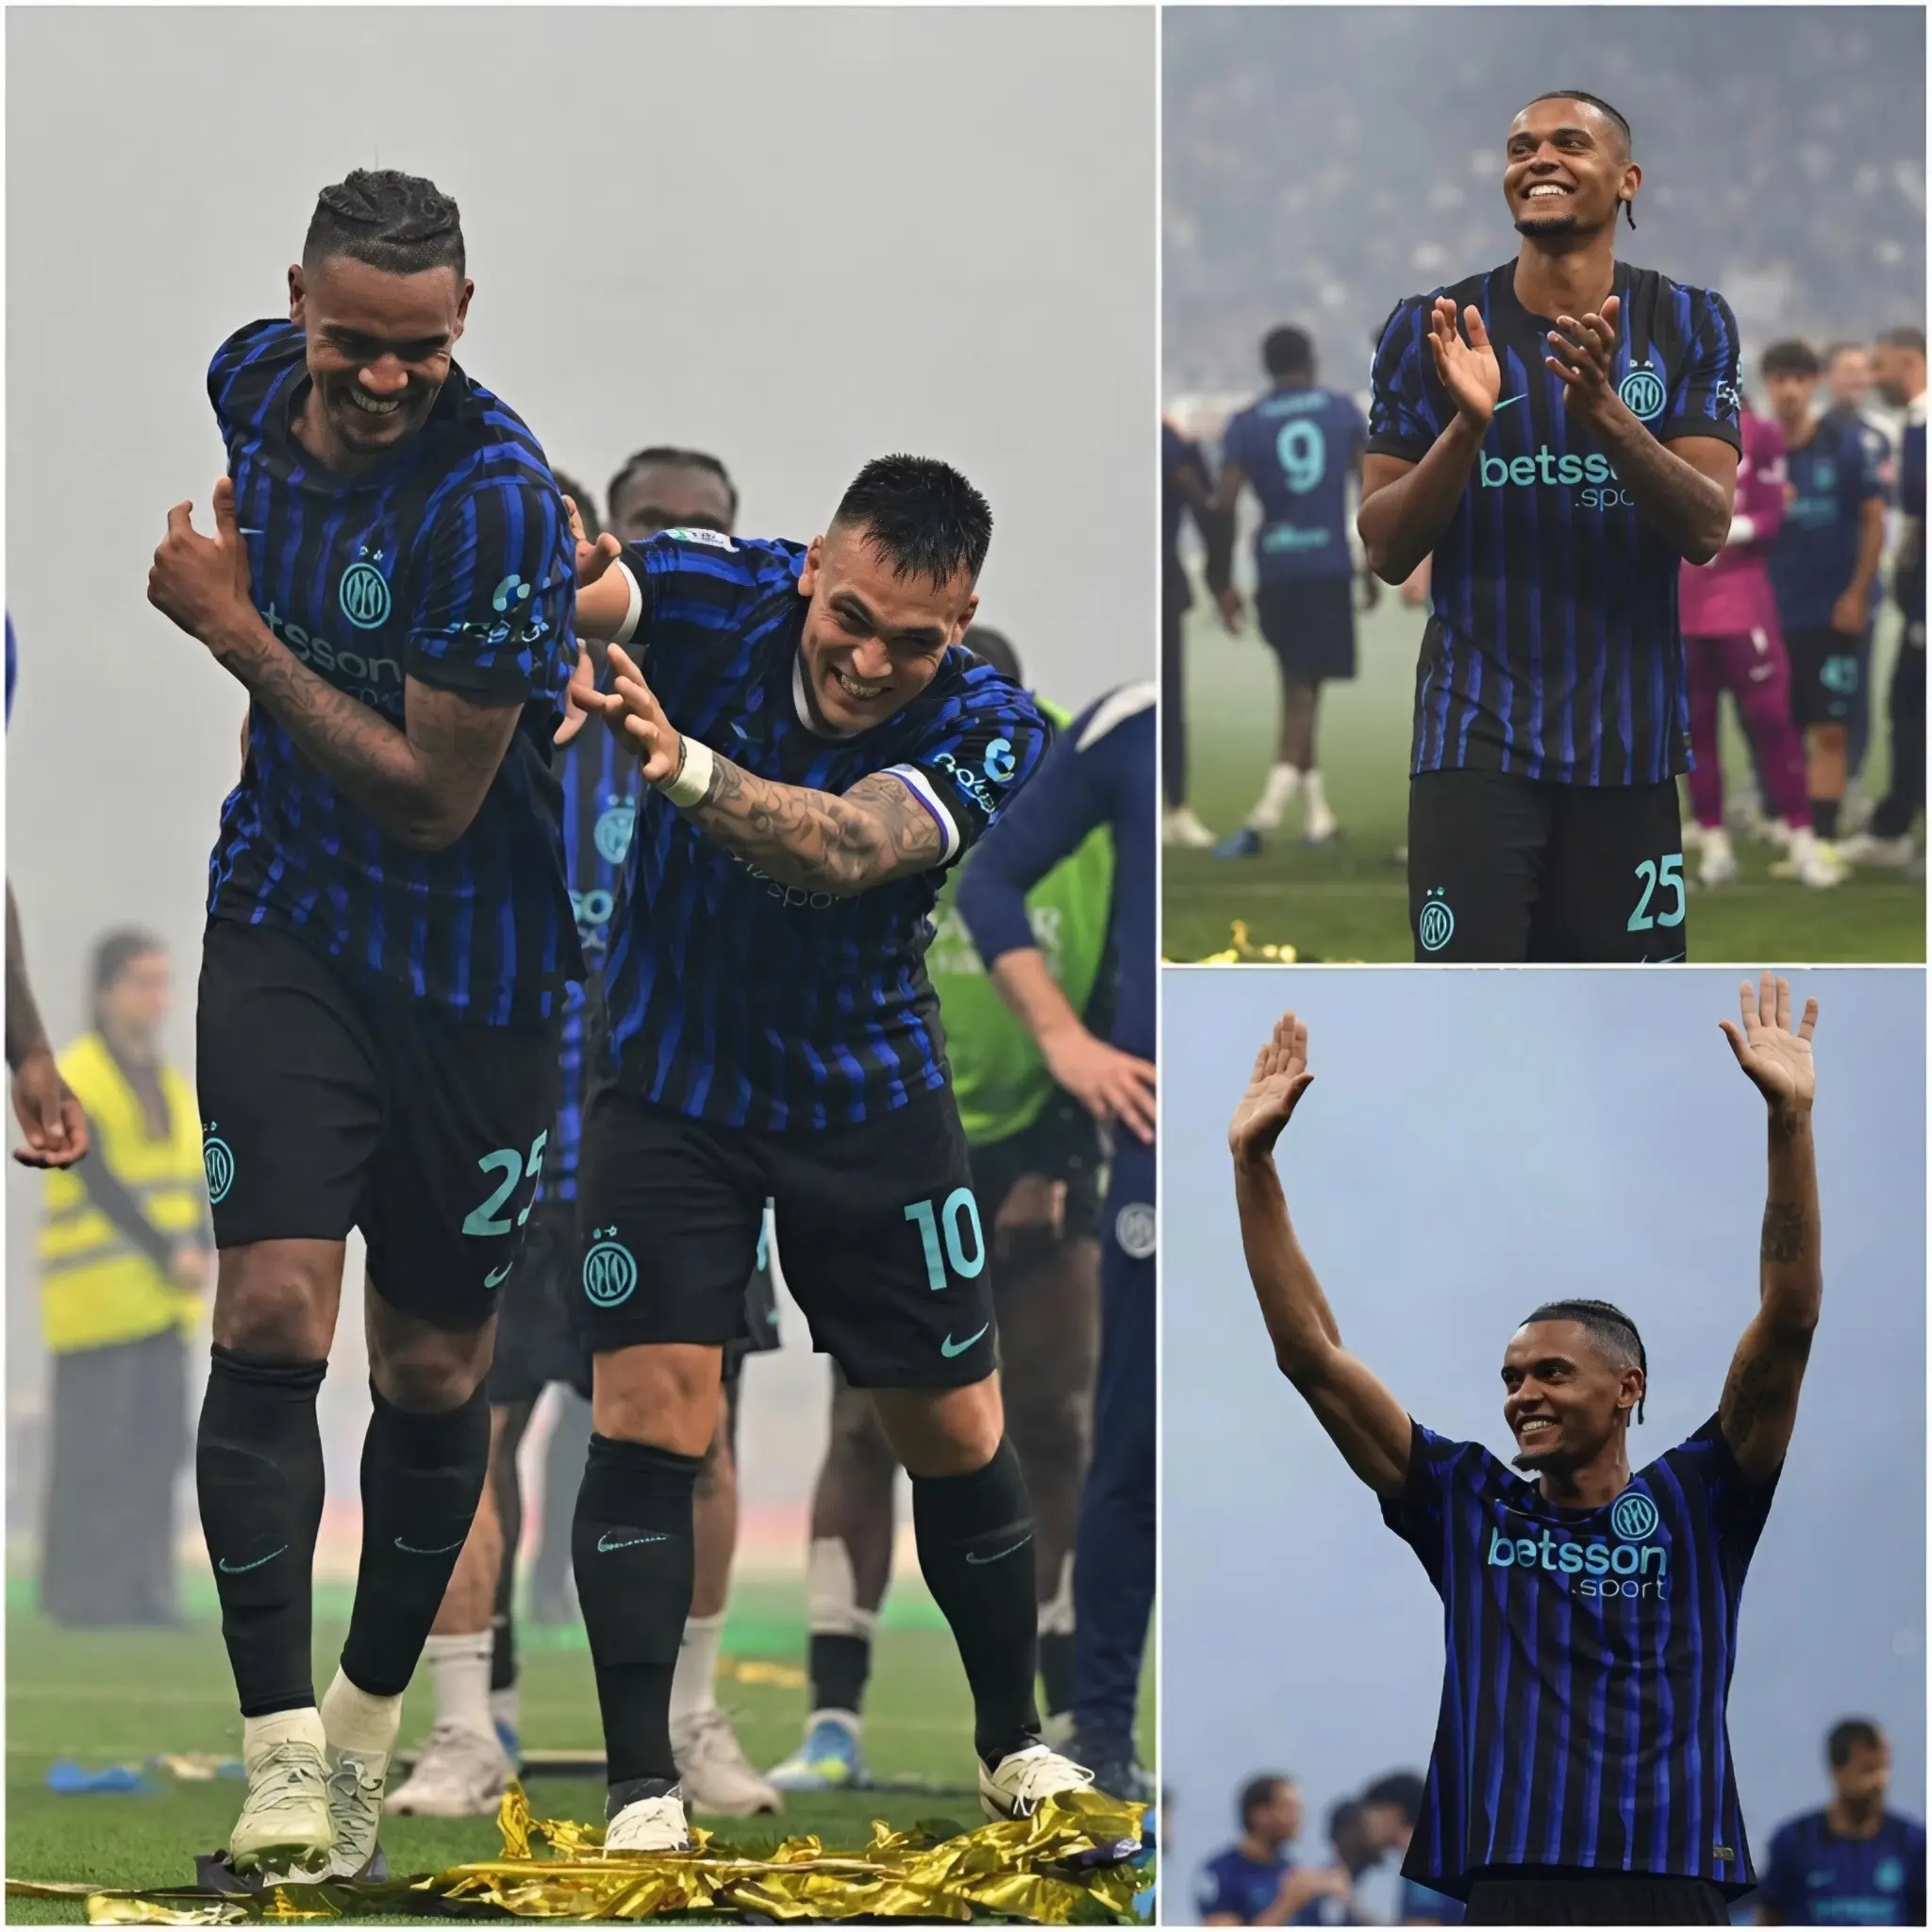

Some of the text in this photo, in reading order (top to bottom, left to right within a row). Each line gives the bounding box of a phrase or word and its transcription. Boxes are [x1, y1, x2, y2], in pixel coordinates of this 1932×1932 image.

[1276, 420, 1325, 494] 9
[1479, 444, 1618, 488] betss
[261, 602, 402, 683] tsson
[1627, 853, 1686, 931] 25
[904, 1187, 985, 1291] 10
[1488, 1526, 1666, 1576] betsson
